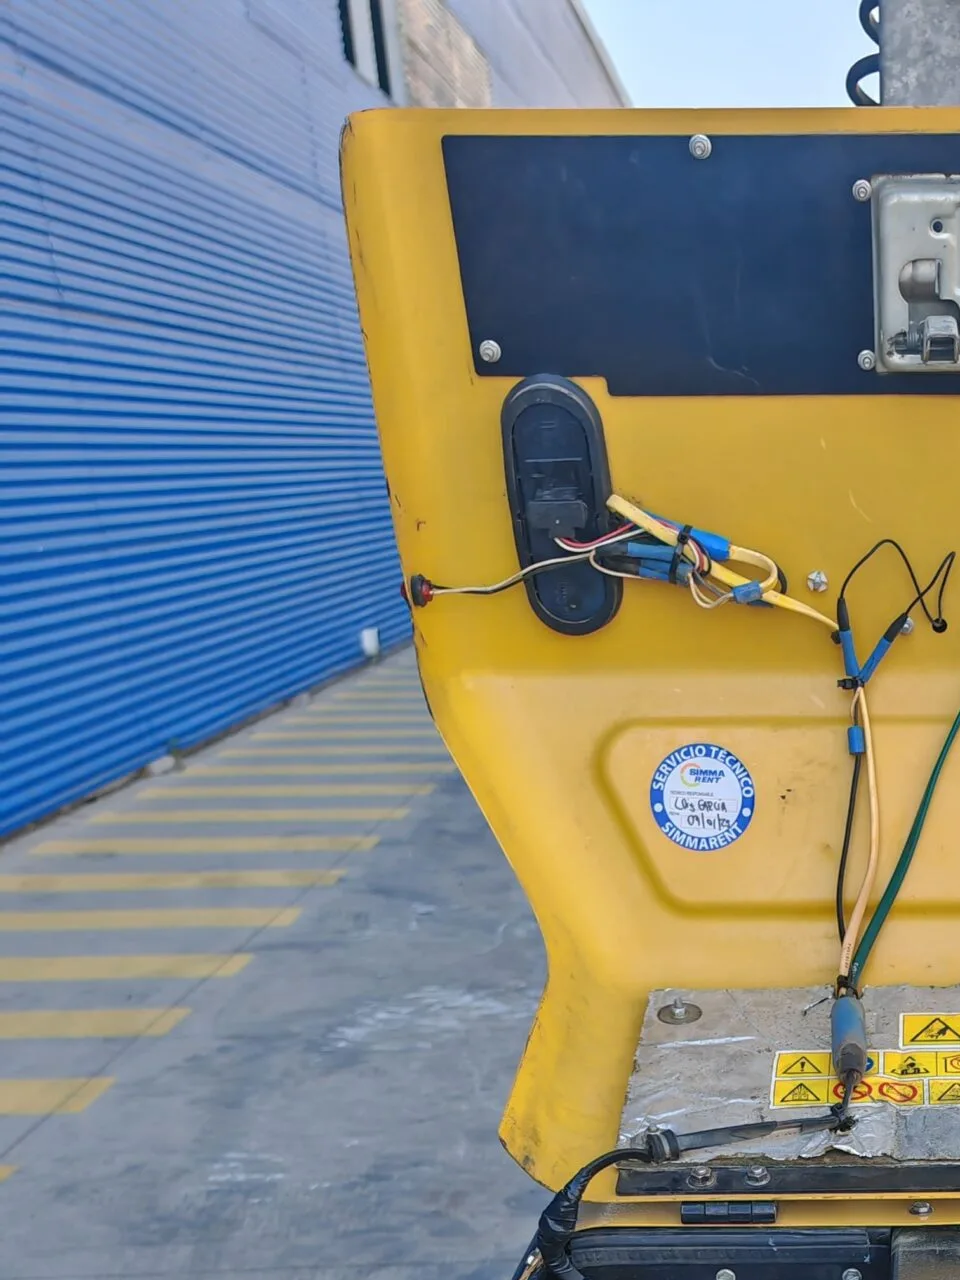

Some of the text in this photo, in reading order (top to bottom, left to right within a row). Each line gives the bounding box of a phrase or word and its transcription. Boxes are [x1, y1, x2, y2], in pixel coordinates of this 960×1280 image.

[653, 745, 754, 798] SERVICIO TÉCNICO
[689, 768, 725, 777] SIMMA
[661, 821, 743, 850] SIMMARENT
